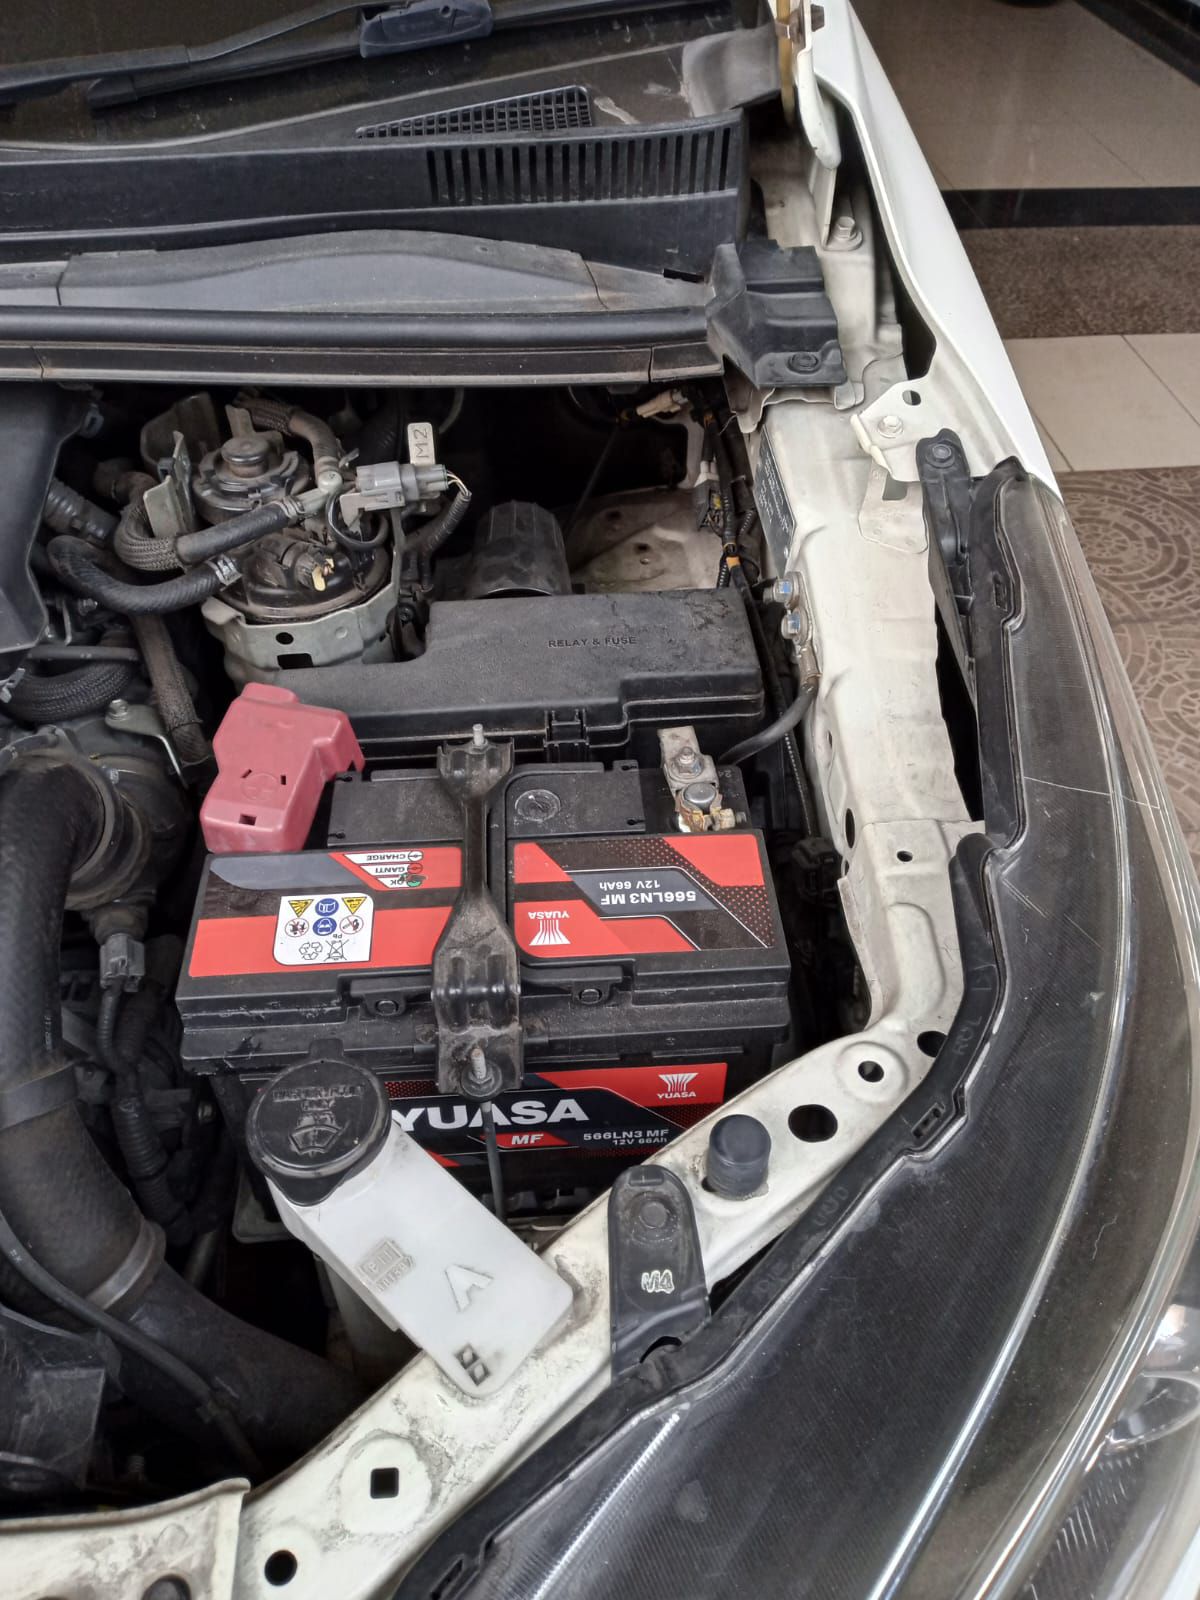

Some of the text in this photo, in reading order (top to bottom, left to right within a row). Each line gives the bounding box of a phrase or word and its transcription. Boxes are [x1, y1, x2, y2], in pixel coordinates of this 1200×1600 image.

[413, 428, 429, 459] M2
[548, 636, 638, 648] RELAY & FUSE
[366, 853, 406, 861] CHARGE
[375, 866, 406, 874] GANTI
[600, 879, 661, 891] 12V 66Ah
[601, 890, 697, 906] 566LN3 MF
[528, 910, 570, 920] YUASA
[657, 1091, 697, 1100] YUASA
[391, 1098, 590, 1132] YUASA
[511, 1133, 544, 1146] MF
[583, 1129, 669, 1141] 566LN3 MF
[612, 1138, 635, 1146] 12V
